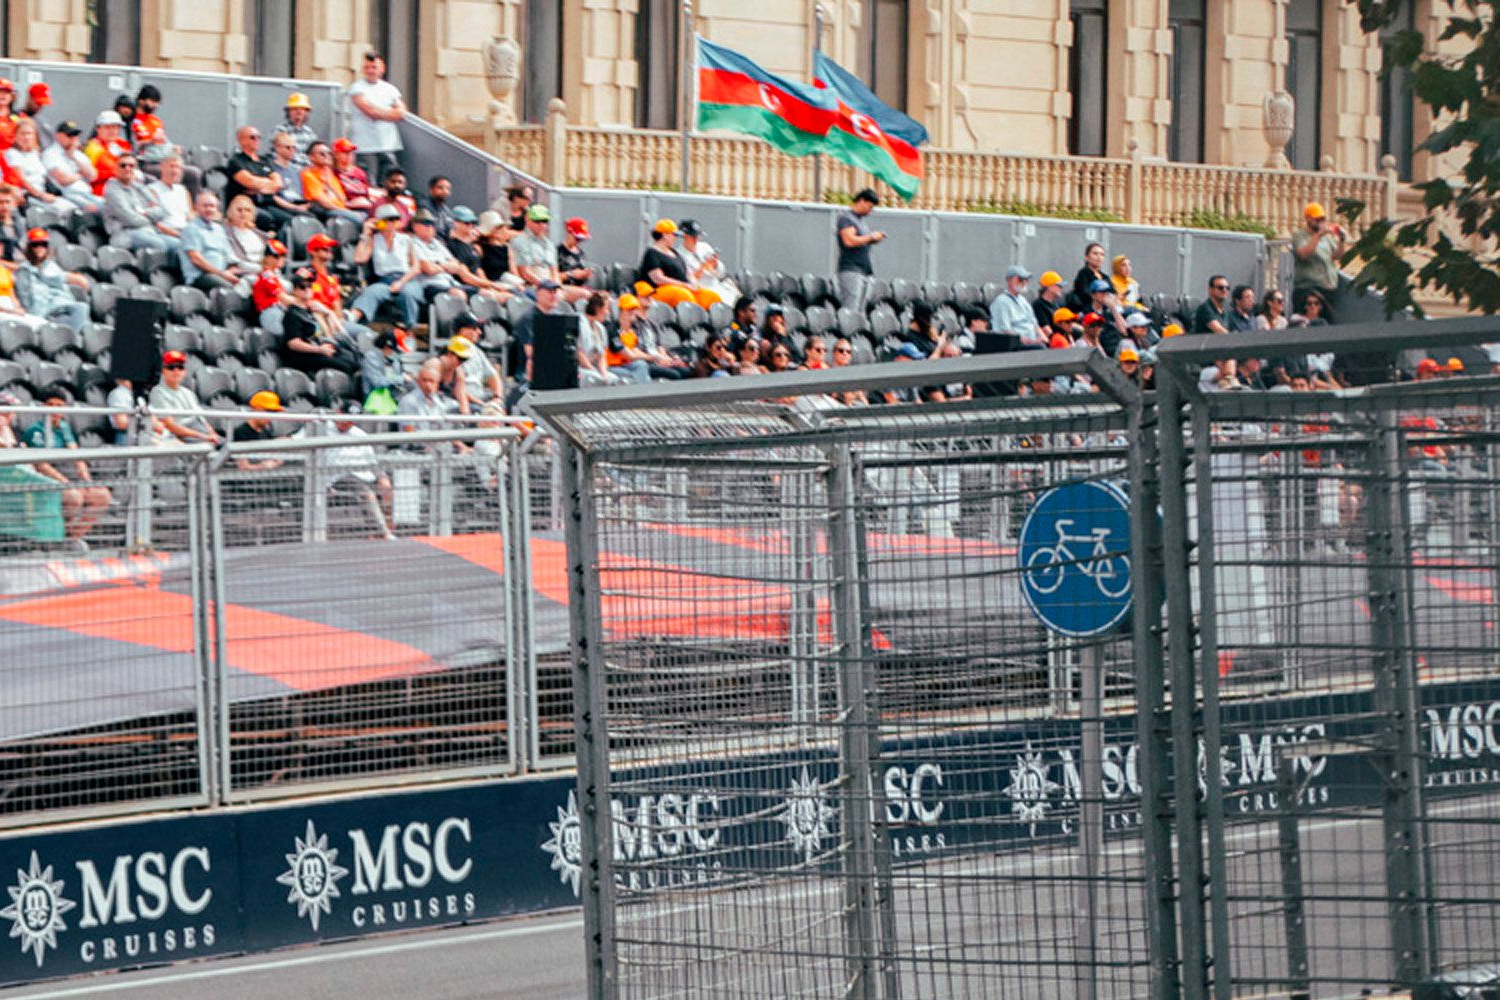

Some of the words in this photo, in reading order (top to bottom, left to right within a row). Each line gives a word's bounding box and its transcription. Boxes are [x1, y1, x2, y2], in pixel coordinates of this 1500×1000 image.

[884, 764, 943, 823] SC
[1240, 786, 1329, 813] CRUES
[611, 792, 719, 860] MSC
[893, 833, 946, 857] ISES
[348, 818, 473, 894] MSC
[76, 847, 211, 929] MSC
[353, 893, 476, 928] CRUISES
[81, 924, 215, 963] CRUISES
